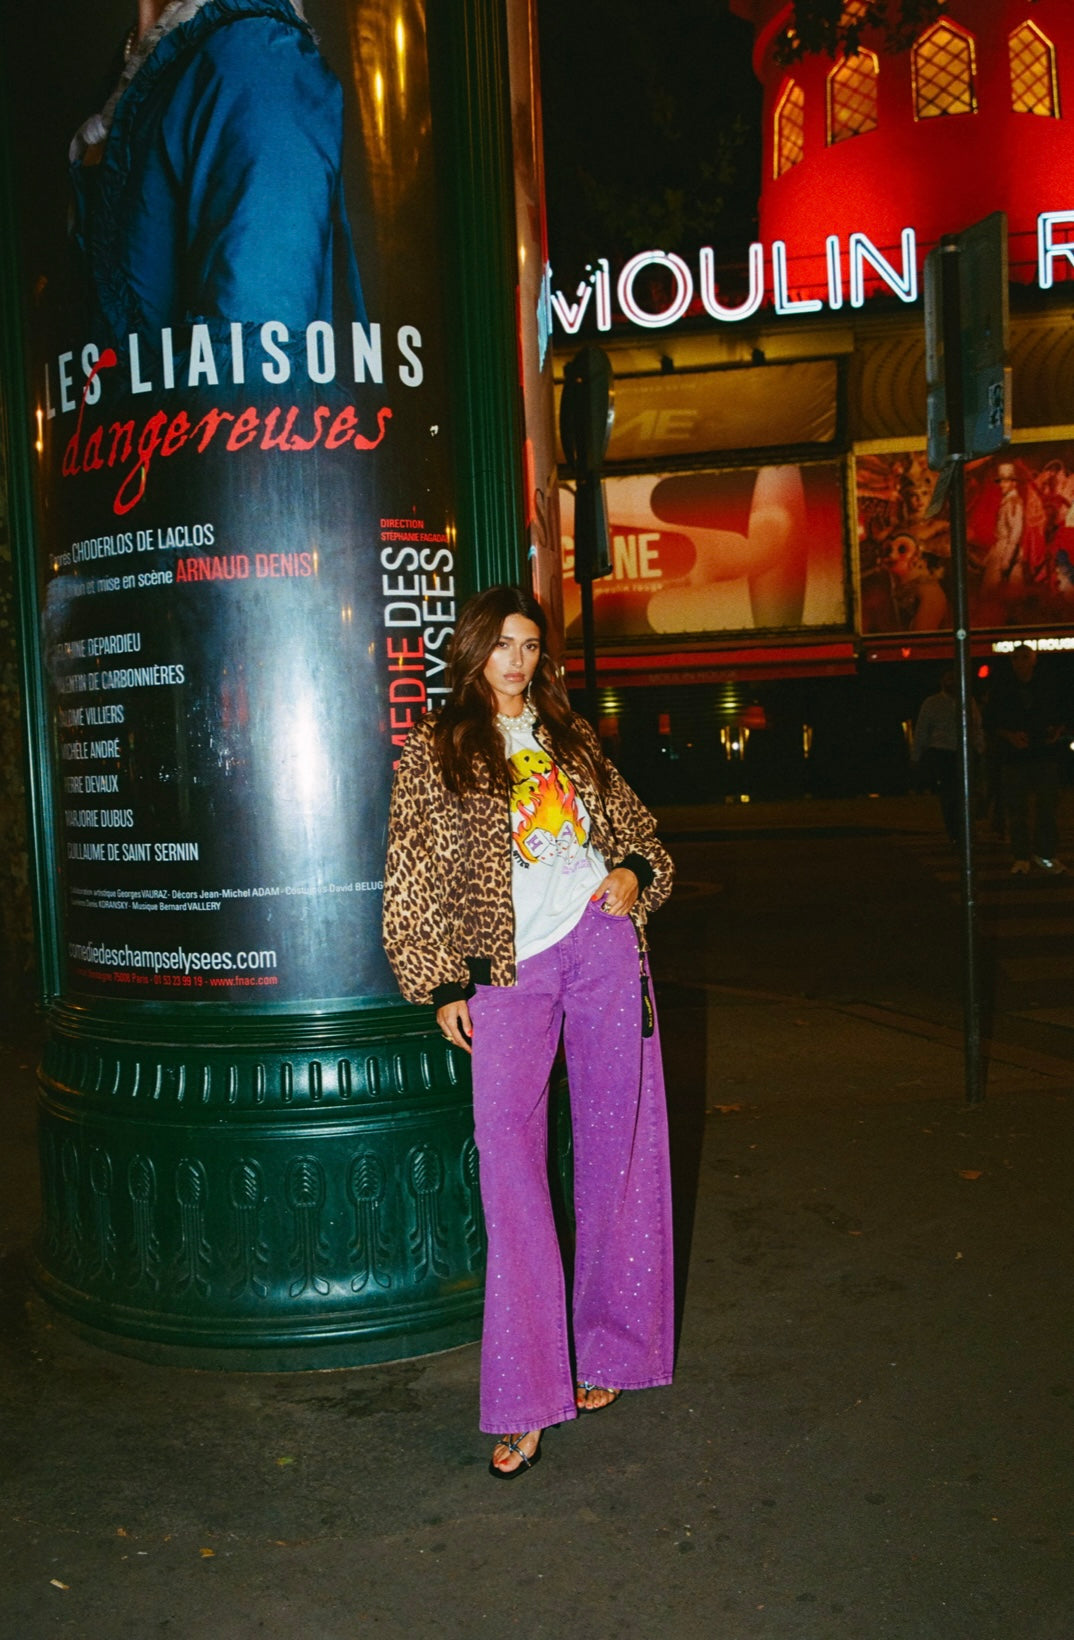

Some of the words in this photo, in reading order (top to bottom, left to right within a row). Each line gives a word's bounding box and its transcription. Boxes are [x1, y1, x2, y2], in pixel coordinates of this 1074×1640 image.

[550, 227, 918, 333] MOULIN
[43, 342, 102, 420] LES
[128, 320, 425, 394] LIAISONS
[61, 348, 393, 516] dangereuses
[380, 518, 425, 529] DIRECTION
[71, 532, 134, 562] CHODERLOS
[136, 530, 154, 551] DE
[157, 523, 215, 550] LACLOS
[97, 575, 121, 593] mise
[122, 573, 136, 589] en
[137, 565, 173, 587] scène
[175, 554, 250, 583] ARNAUD
[255, 551, 312, 578] DENIS
[380, 546, 422, 627] DES
[87, 632, 141, 657] DEPARDIEU
[88, 672, 100, 691] DE
[101, 663, 186, 690] CARBONNIÈRES
[84, 704, 125, 726] VILLIERS
[90, 737, 121, 760] ANDRÉ
[85, 774, 119, 793] DEVAUX
[100, 808, 134, 828] DUBUS
[107, 843, 120, 861] DE
[121, 843, 152, 862] SAINT
[154, 842, 200, 862] SERNIN
[116, 888, 141, 900] Georges
[171, 888, 198, 899] Décors
[199, 887, 251, 899] Jean-Michel
[251, 886, 280, 898] ADAM
[131, 901, 158, 912] Musique
[159, 901, 187, 911] Bernard
[187, 901, 221, 911] VALLERY
[209, 974, 278, 987] www.fnac.com
